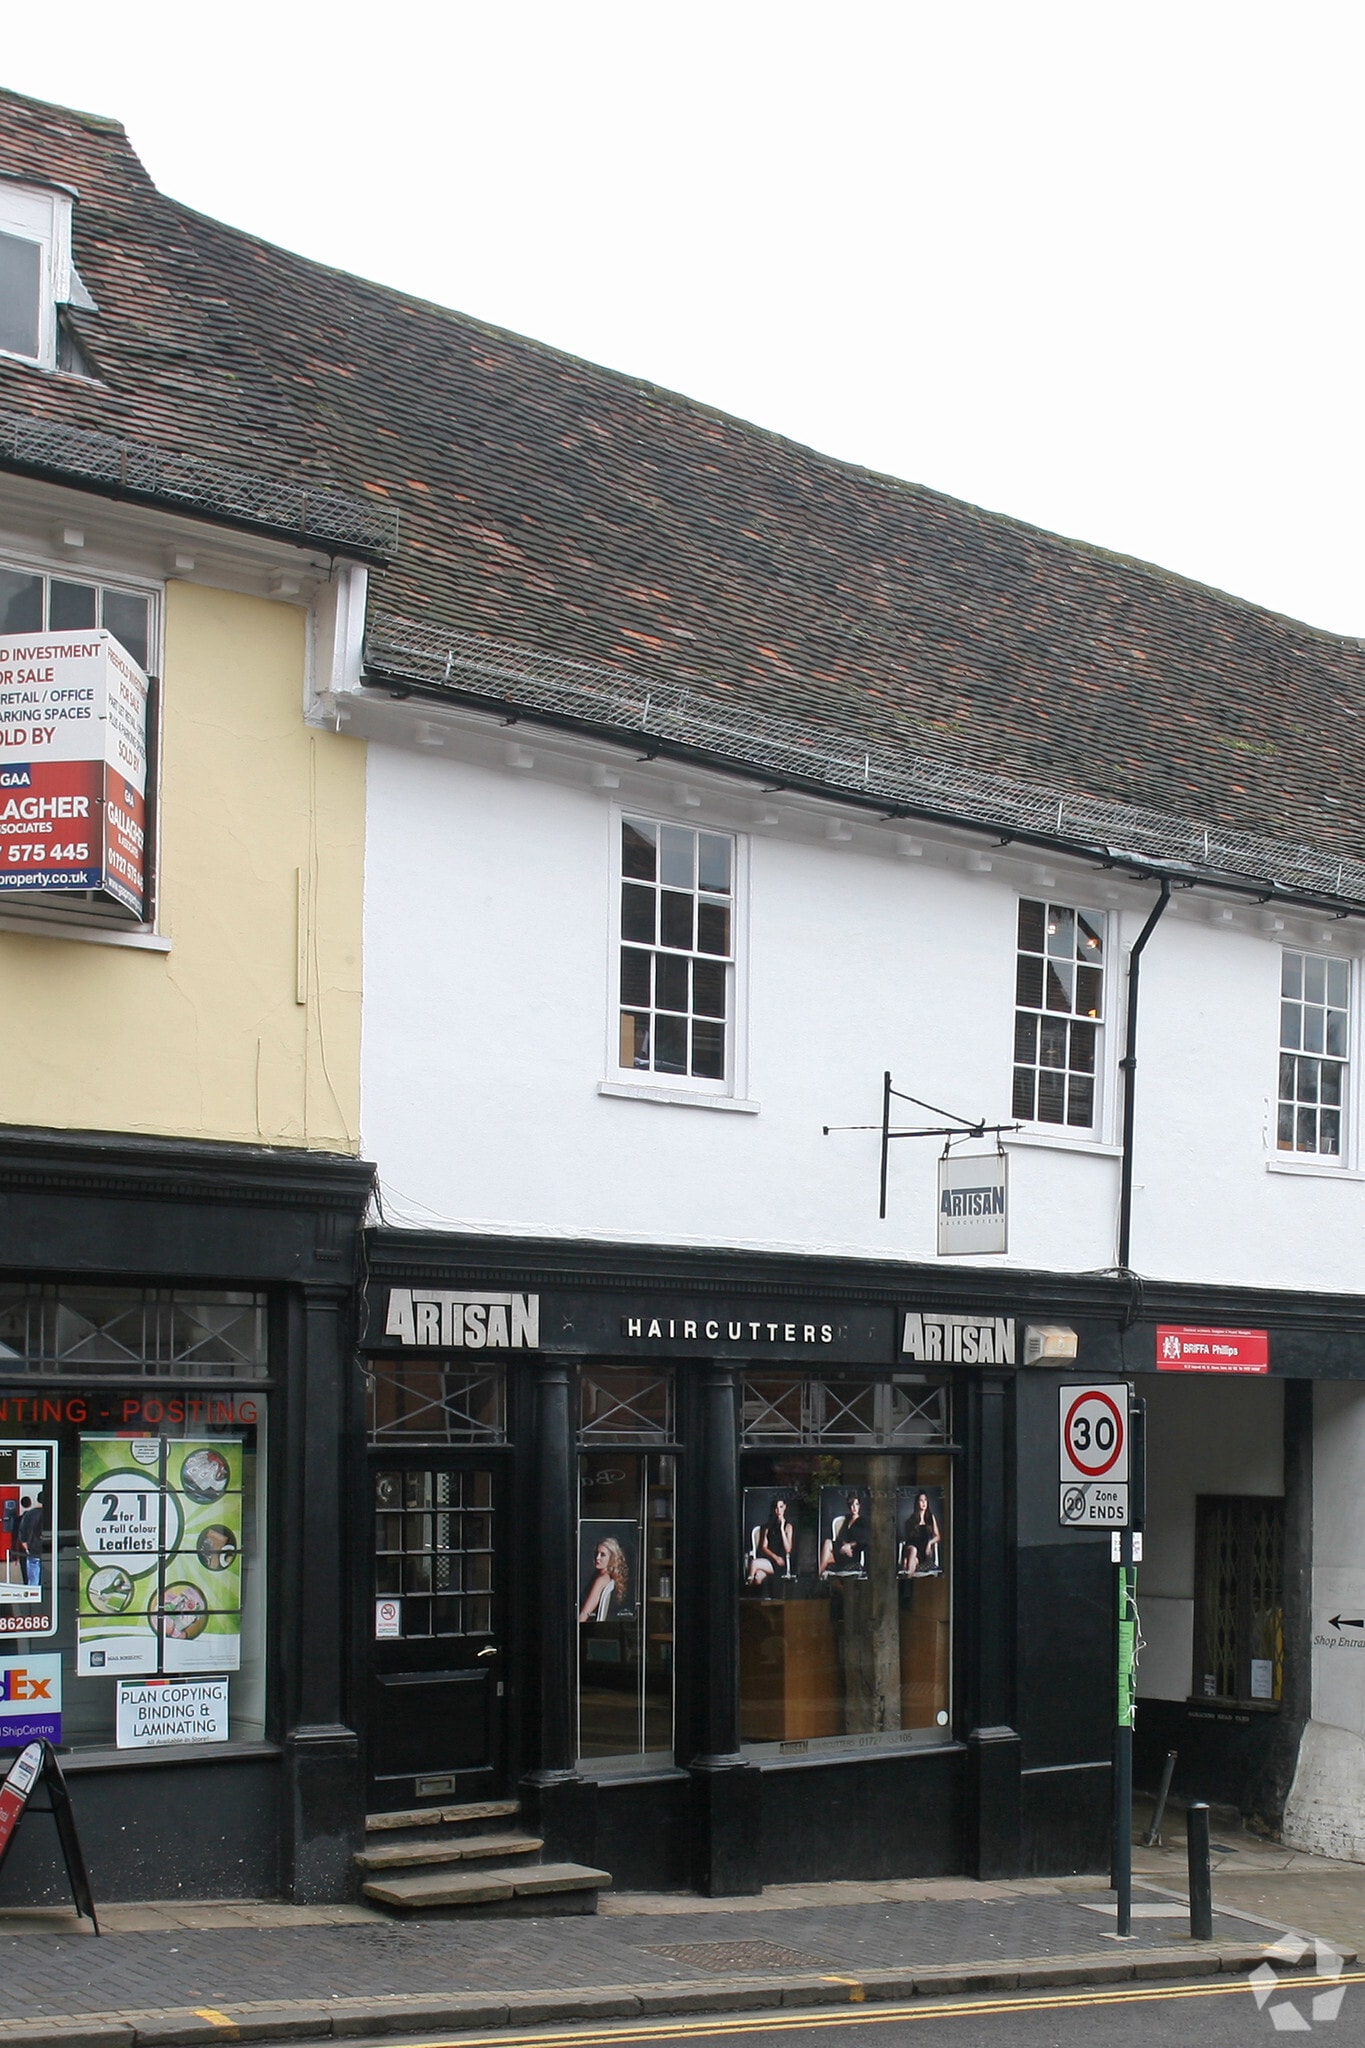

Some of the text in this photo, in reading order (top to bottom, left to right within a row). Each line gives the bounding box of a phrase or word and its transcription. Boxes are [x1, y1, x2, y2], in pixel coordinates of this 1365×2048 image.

[13, 644, 101, 661] INVESTMENT
[17, 668, 54, 684] SALE
[1, 689, 94, 705] RETAIL / OFFICE
[45, 707, 91, 720] SPACES
[32, 727, 56, 744] BY
[0, 772, 30, 786] GAA
[8, 844, 46, 862] 575
[50, 843, 89, 861] 445
[941, 1186, 1005, 1217] ARTISAN
[385, 1288, 540, 1349] ARTISAN
[627, 1318, 833, 1343] HAIRCUTTERS
[902, 1313, 1016, 1365] ARTISAN
[1183, 1343, 1210, 1355] BRIFFA
[122, 1399, 258, 1424] POSTING
[1073, 1416, 1115, 1451] 30
[1066, 1497, 1083, 1511] 20
[1095, 1490, 1118, 1502] Zone
[102, 1494, 147, 1521] 2 for 1
[1089, 1505, 1124, 1519] ENDS
[110, 1524, 126, 1533] Full
[129, 1524, 157, 1533] Colour
[1313, 1635, 1337, 1648] Shop
[121, 1686, 227, 1704] PLAN COPYING,
[139, 1703, 211, 1720] BINDING &
[134, 1719, 217, 1737] LAMINATING
